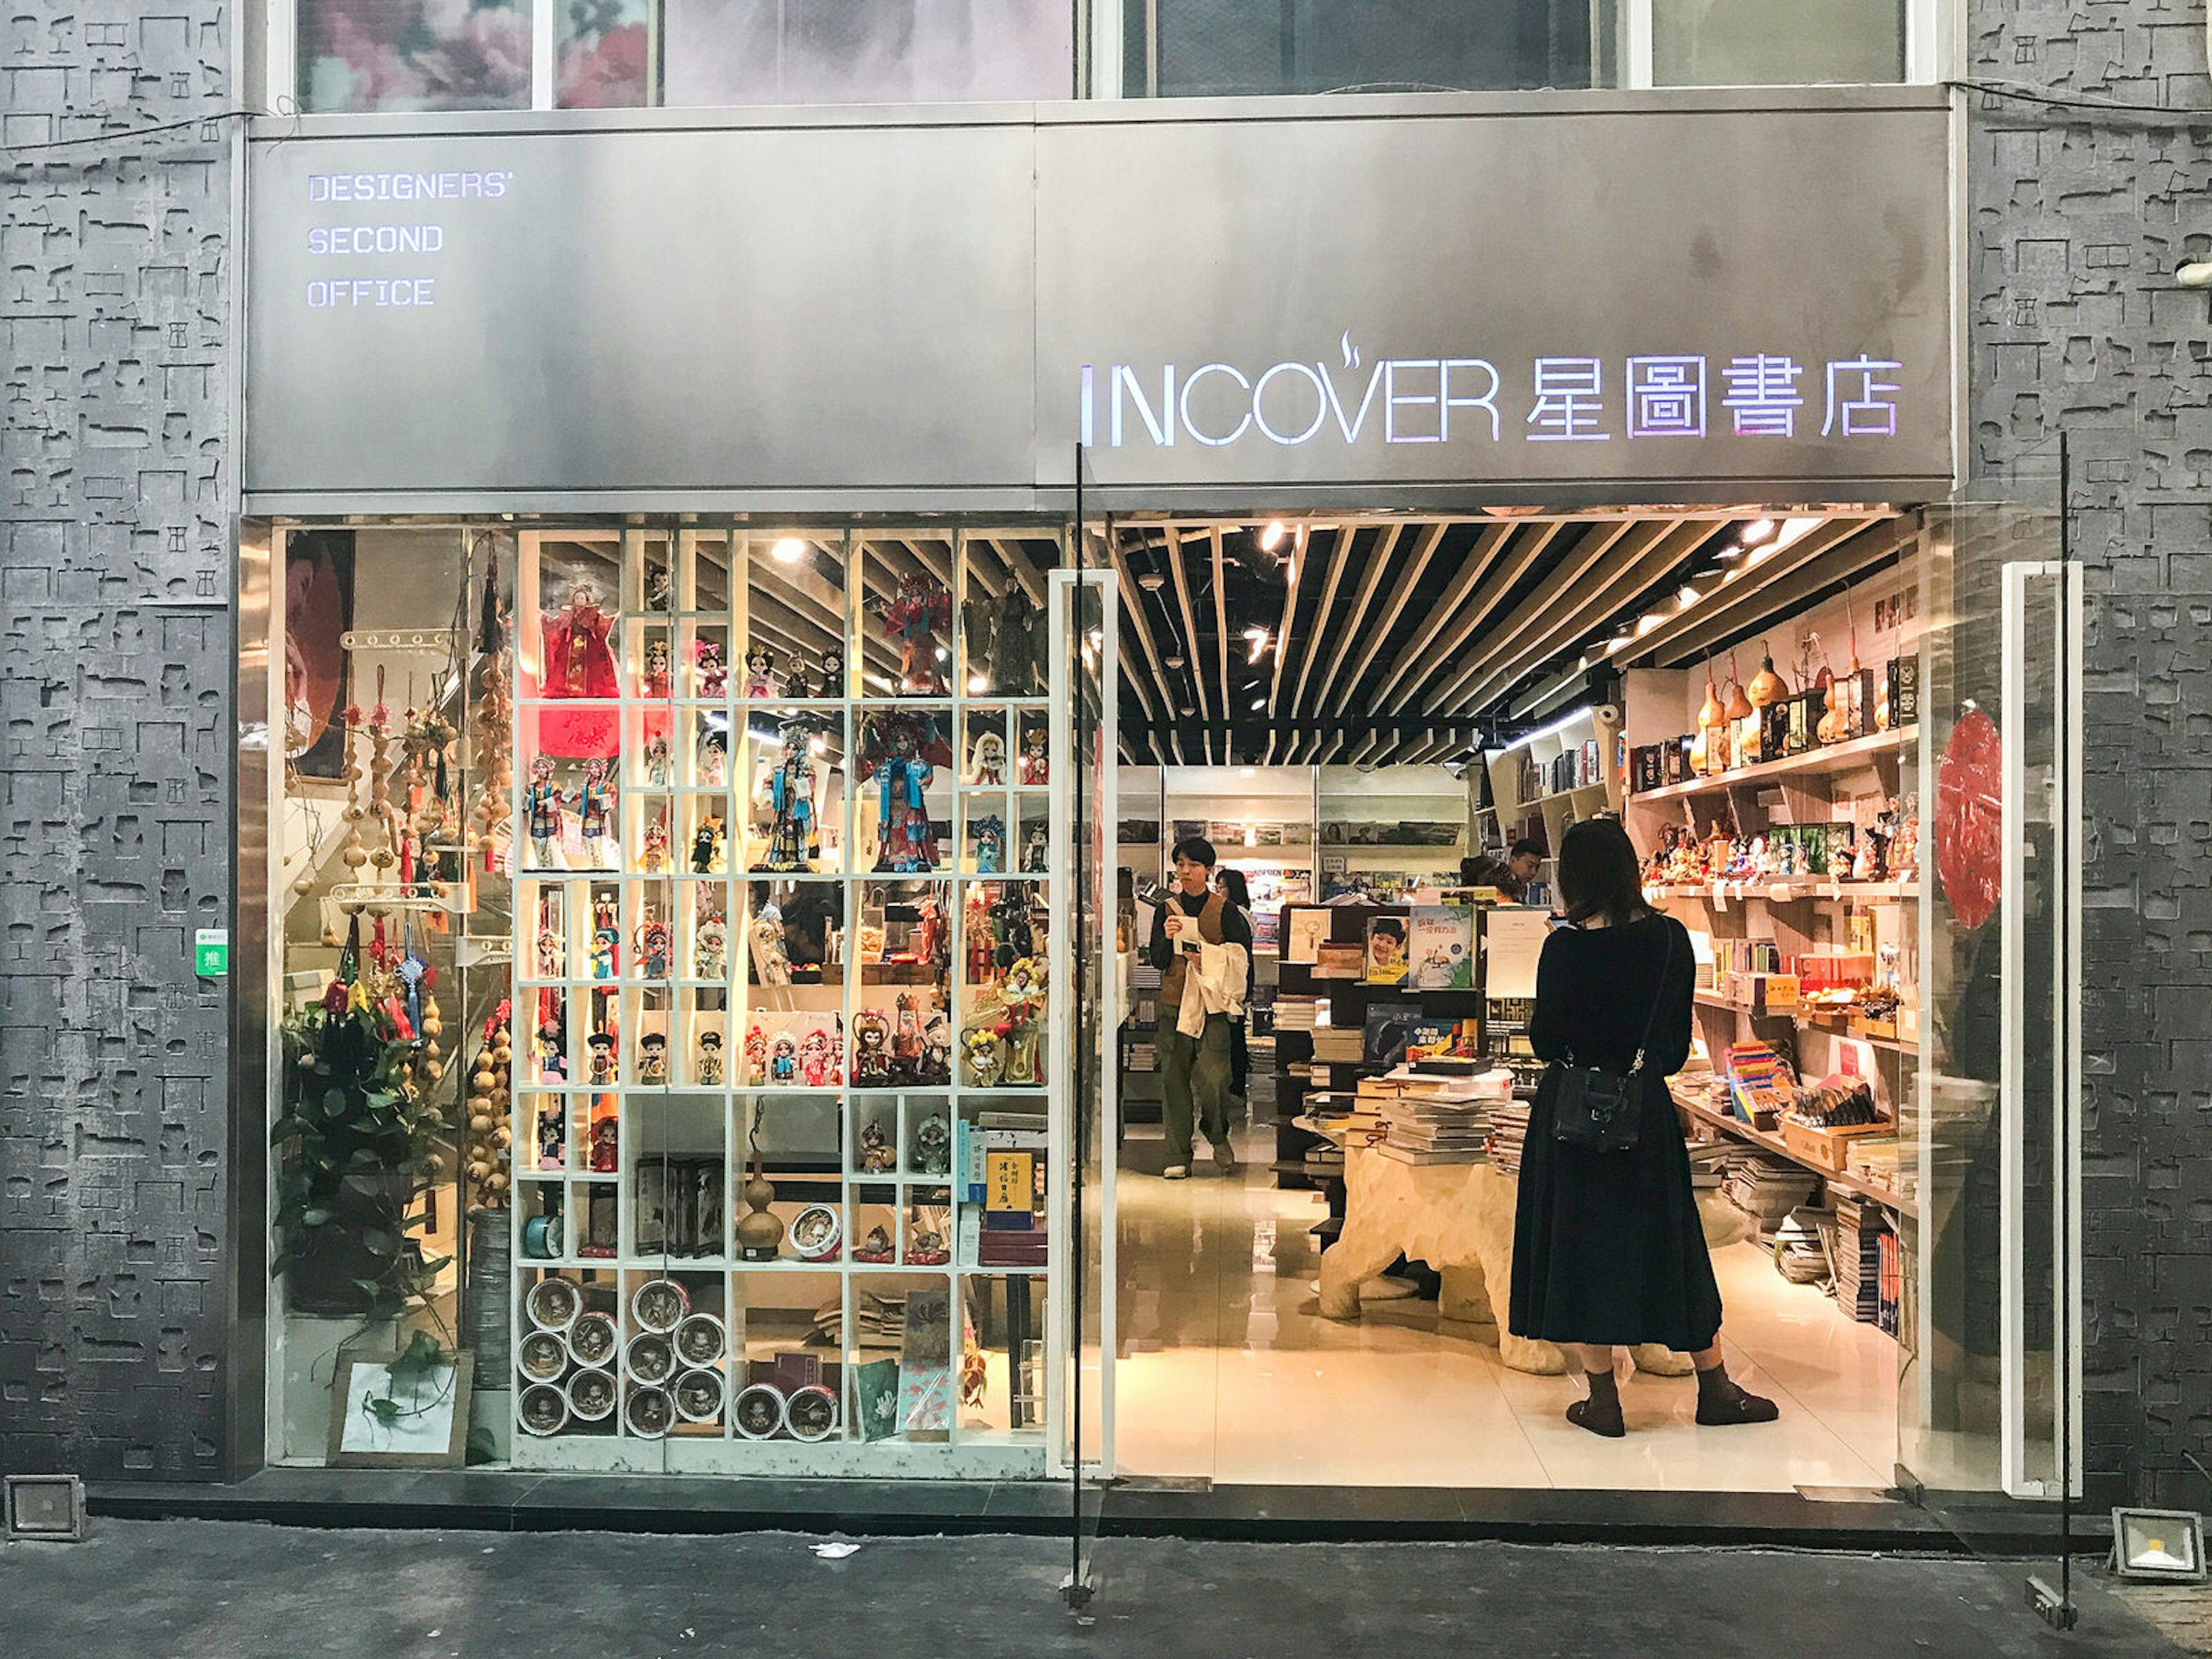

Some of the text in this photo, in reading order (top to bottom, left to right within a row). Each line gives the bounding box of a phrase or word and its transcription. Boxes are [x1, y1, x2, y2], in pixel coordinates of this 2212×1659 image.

[308, 169, 513, 201] DESIGNERS'
[307, 225, 444, 255] SECOND
[306, 278, 434, 308] OFFICE
[1080, 354, 1904, 448] INCOVER 星圖書店
